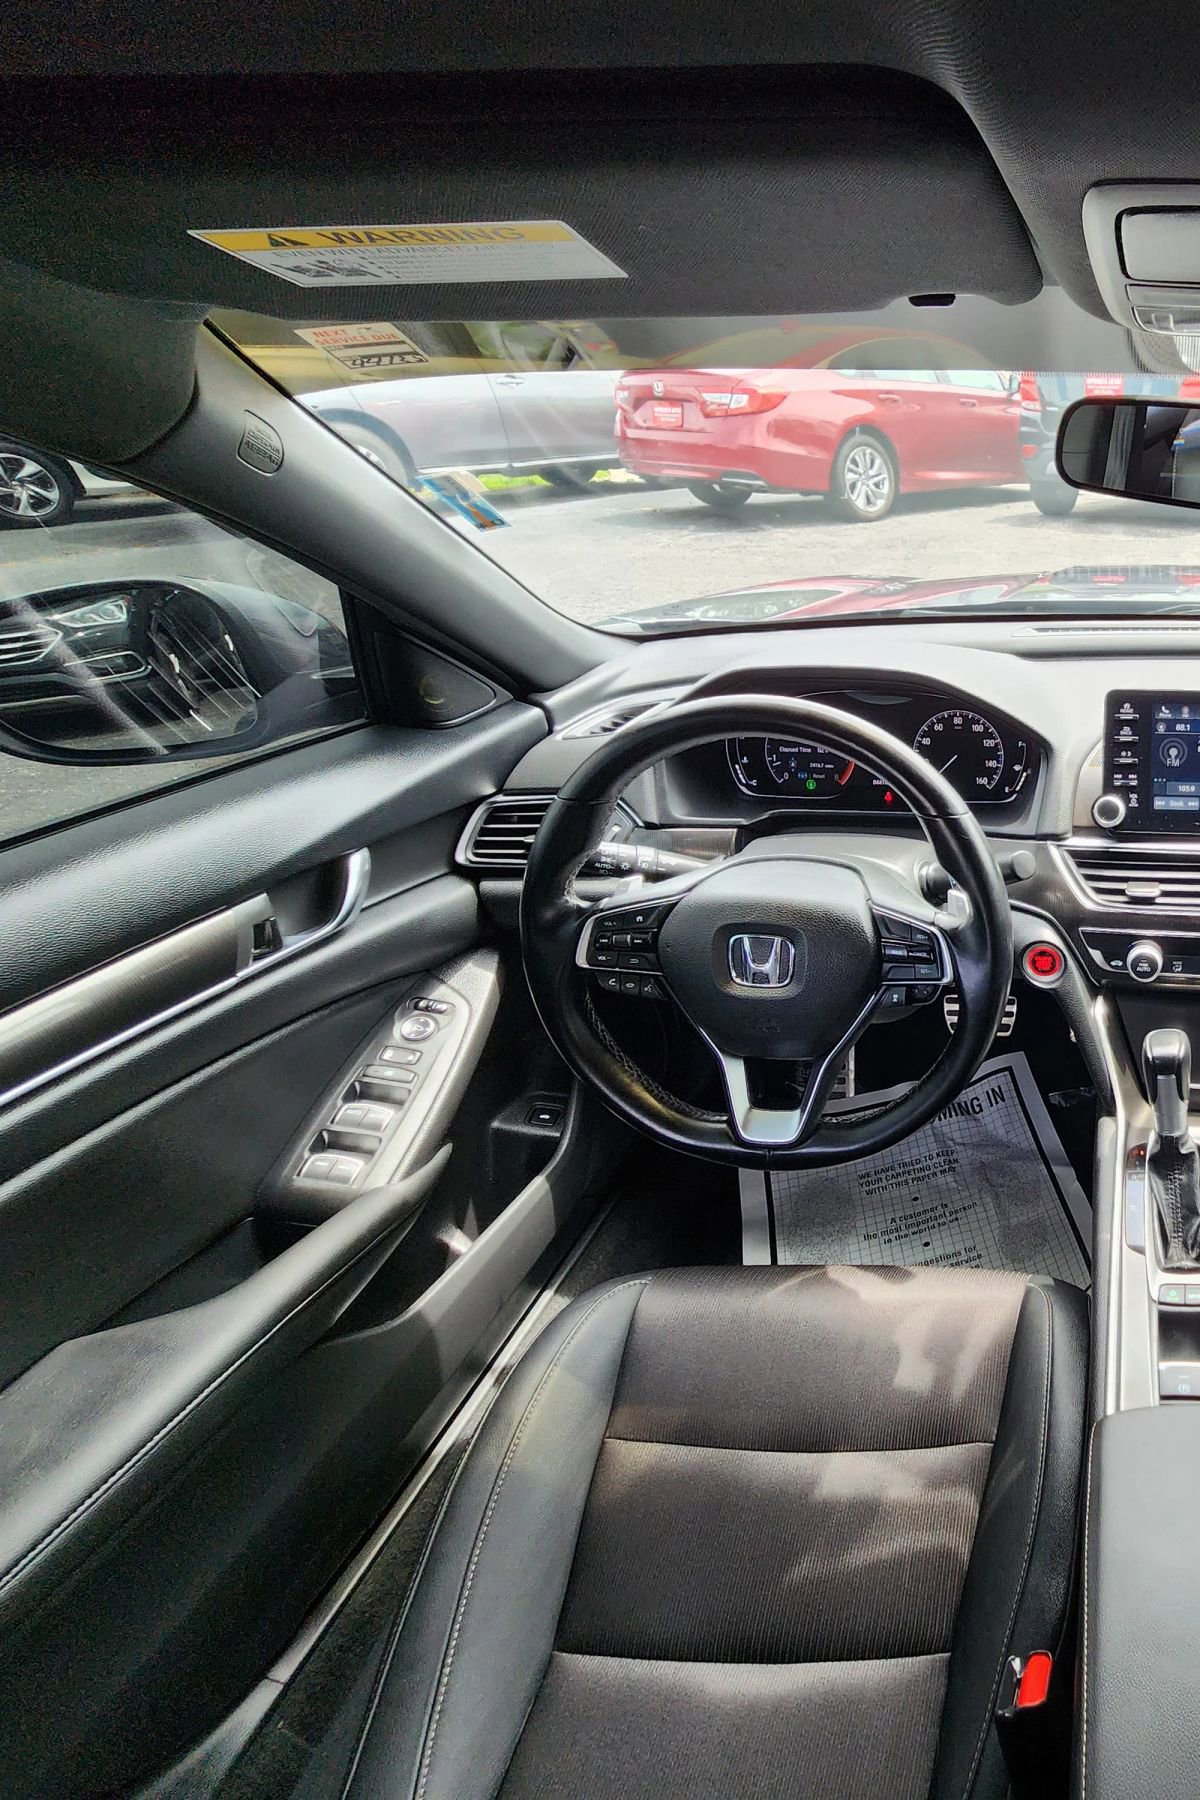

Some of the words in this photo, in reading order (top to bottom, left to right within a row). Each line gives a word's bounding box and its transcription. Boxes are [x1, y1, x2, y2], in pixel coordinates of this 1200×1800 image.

[316, 226, 525, 244] WARNING
[312, 329, 348, 338] NEXT
[953, 717, 963, 725] 80
[972, 724, 984, 732] 100
[983, 739, 995, 747] 120
[985, 760, 997, 768] 140
[1166, 758, 1180, 767] FM
[783, 772, 789, 780] 0
[976, 777, 988, 785] 160
[985, 1085, 1006, 1107] IN
[858, 1172, 873, 1181] WE
[874, 1166, 895, 1177] HAVE
[898, 1158, 921, 1169] TRIED
[924, 1153, 934, 1162] TO
[936, 1149, 955, 1159] KEEP
[859, 1177, 883, 1188] YOUR
[885, 1165, 931, 1182] CARPETING
[933, 1158, 958, 1169] CLEAN
[865, 1185, 888, 1196] WITH
[890, 1180, 909, 1190] THIS
[911, 1172, 937, 1184] PAPER
[940, 1166, 957, 1176] MAT
[898, 1205, 938, 1221] customer
[863, 1233, 878, 1241] the
[880, 1226, 902, 1236] most
[949, 1201, 978, 1217] person
[911, 1223, 936, 1235] world
[964, 1245, 977, 1254] for
